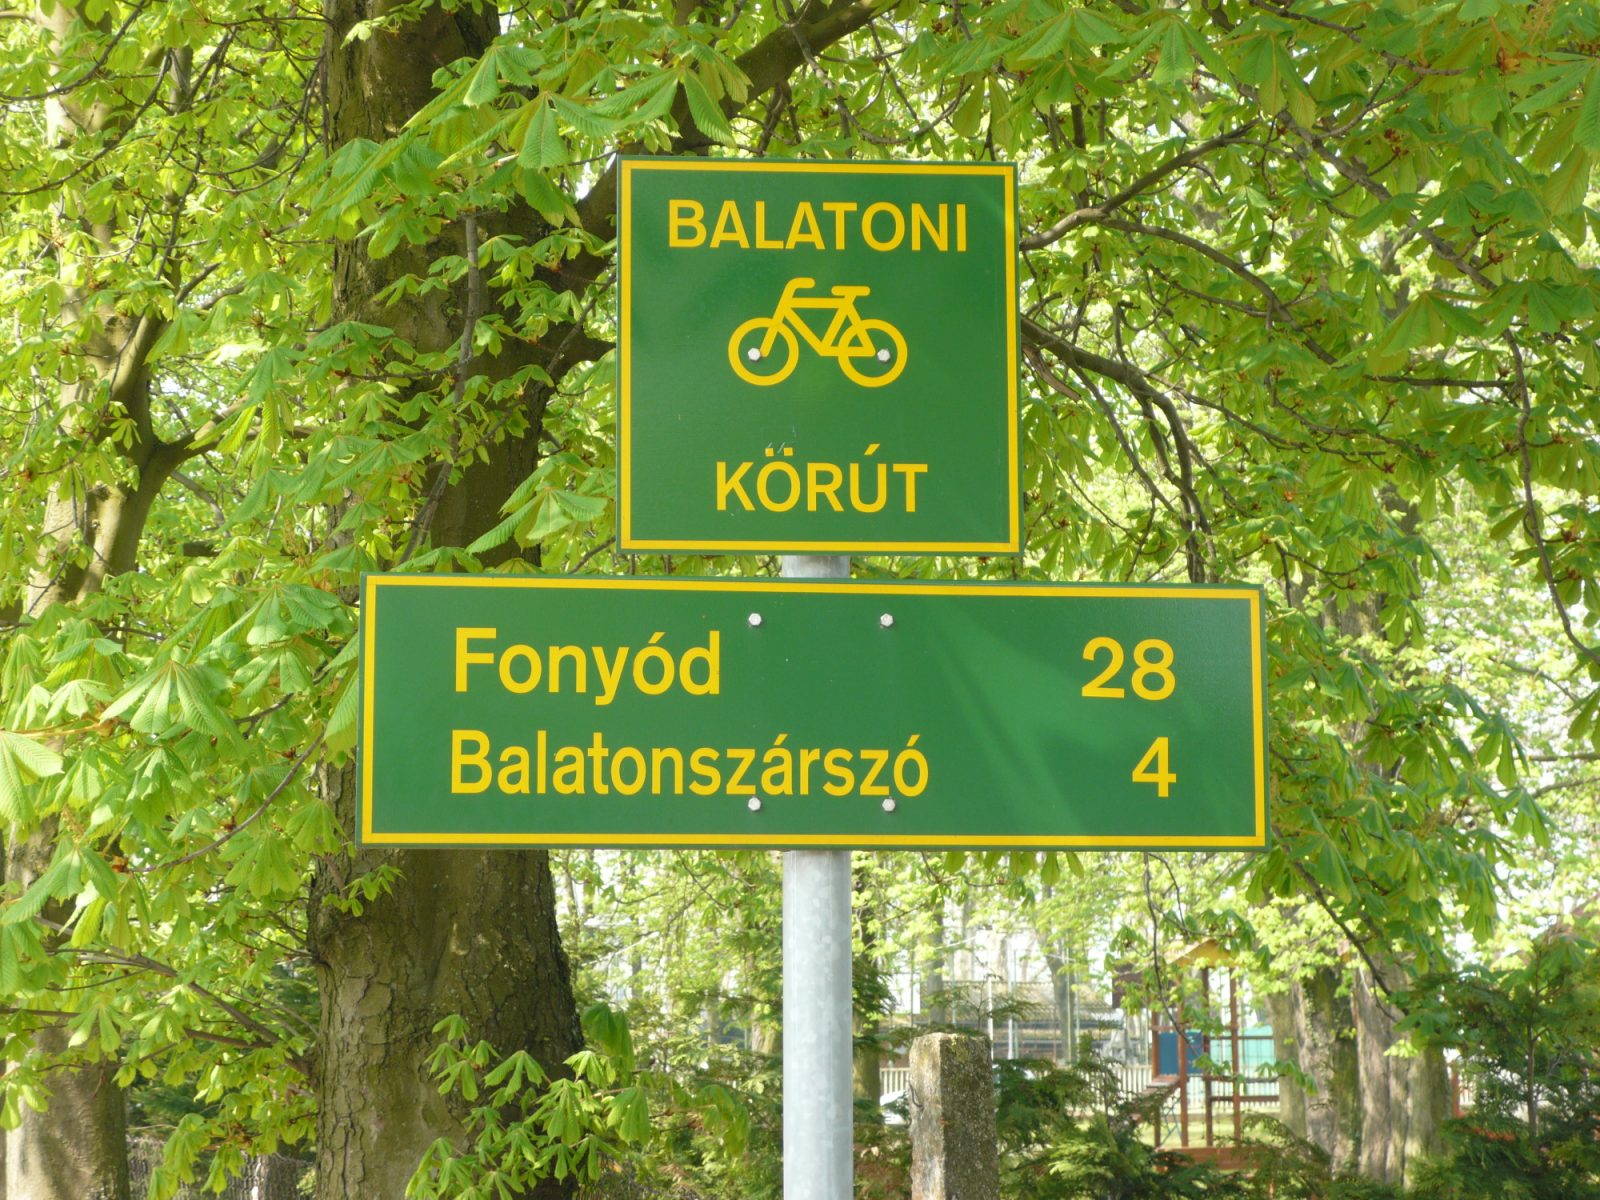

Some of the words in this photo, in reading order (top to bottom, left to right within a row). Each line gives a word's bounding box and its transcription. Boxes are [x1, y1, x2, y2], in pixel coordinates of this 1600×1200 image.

[668, 199, 967, 252] BALATONI
[716, 443, 929, 514] KÖRÚT
[455, 626, 721, 706] Fonyód
[1081, 636, 1176, 701] 28
[450, 729, 929, 798] Balatonszárszó
[1131, 736, 1177, 799] 4
